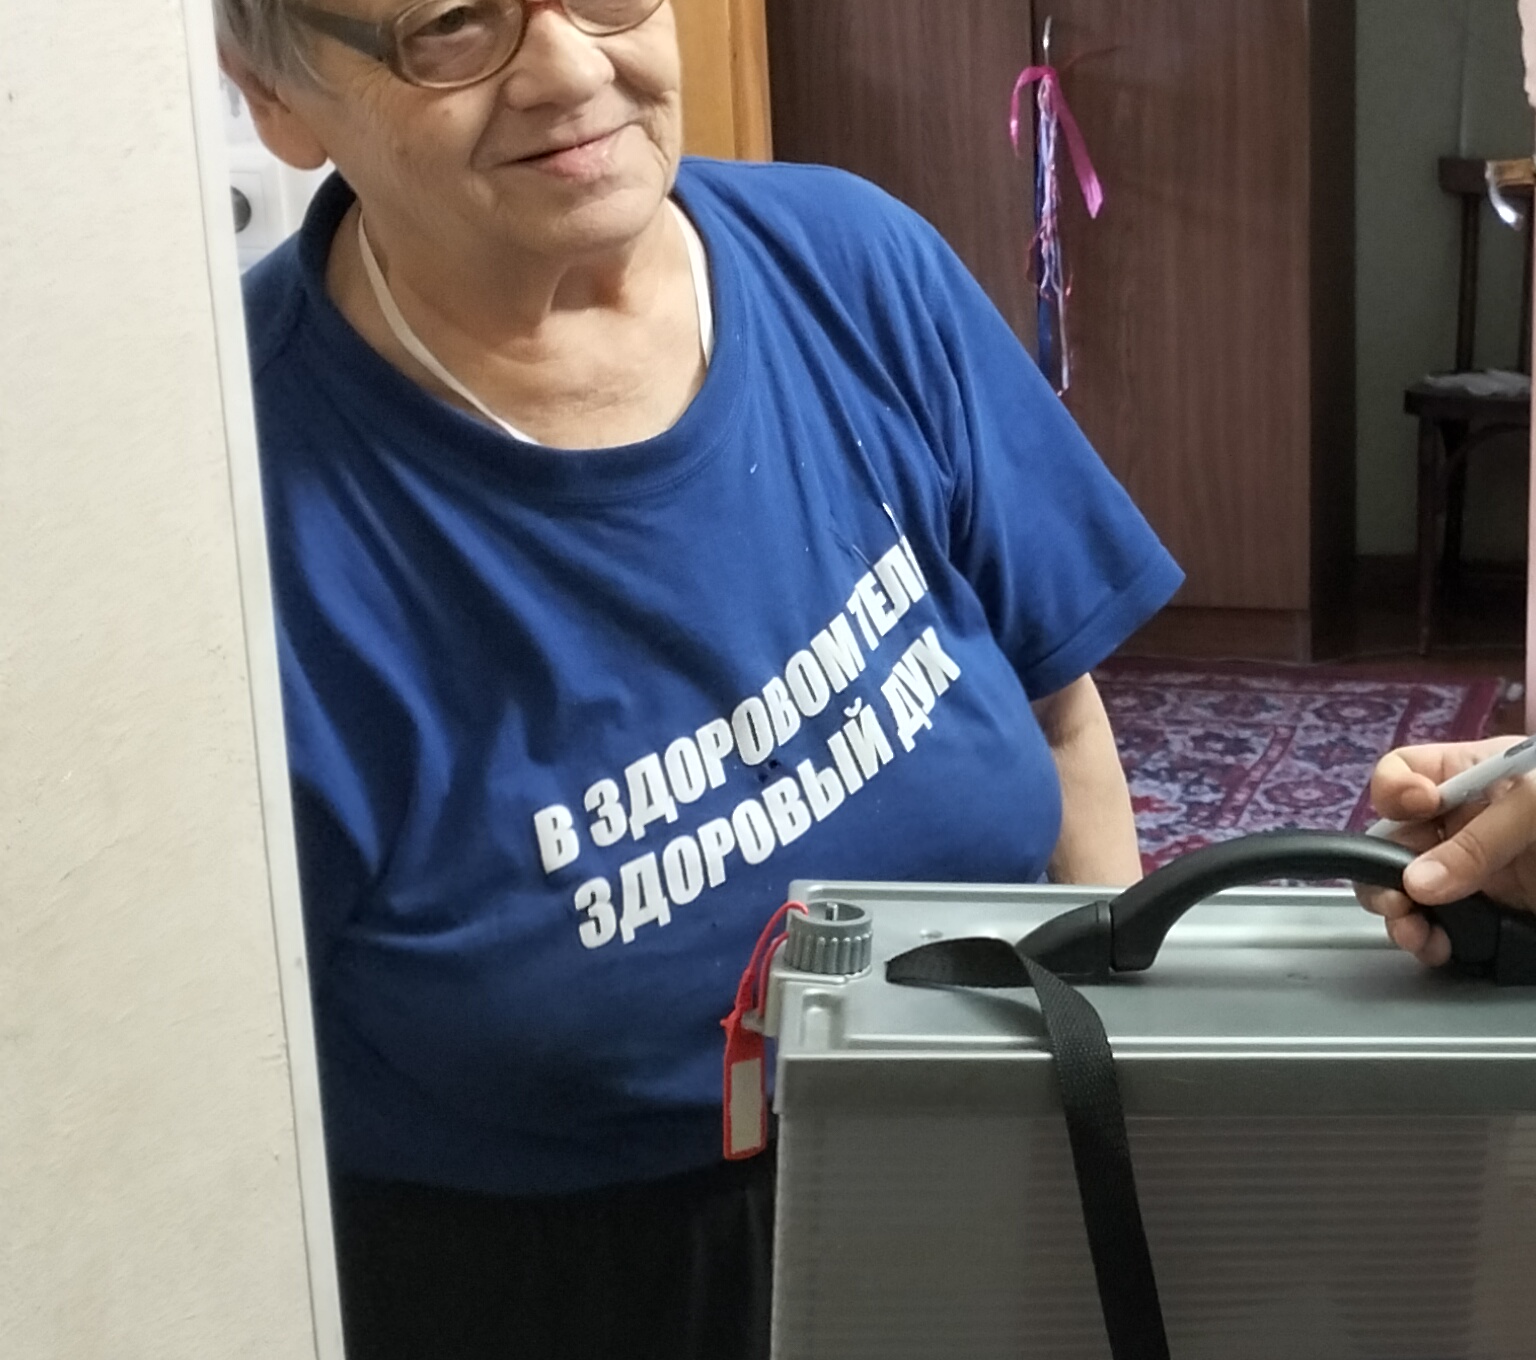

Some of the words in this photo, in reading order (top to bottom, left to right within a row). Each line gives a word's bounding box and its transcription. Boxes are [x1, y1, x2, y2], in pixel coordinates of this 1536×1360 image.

[534, 804, 580, 874] В
[584, 612, 867, 848] ЗДОРОВОМ
[846, 535, 929, 651] ТЕЛ
[573, 697, 894, 948] ЗДОРОВЫЙ
[880, 626, 961, 752] ДУХ
